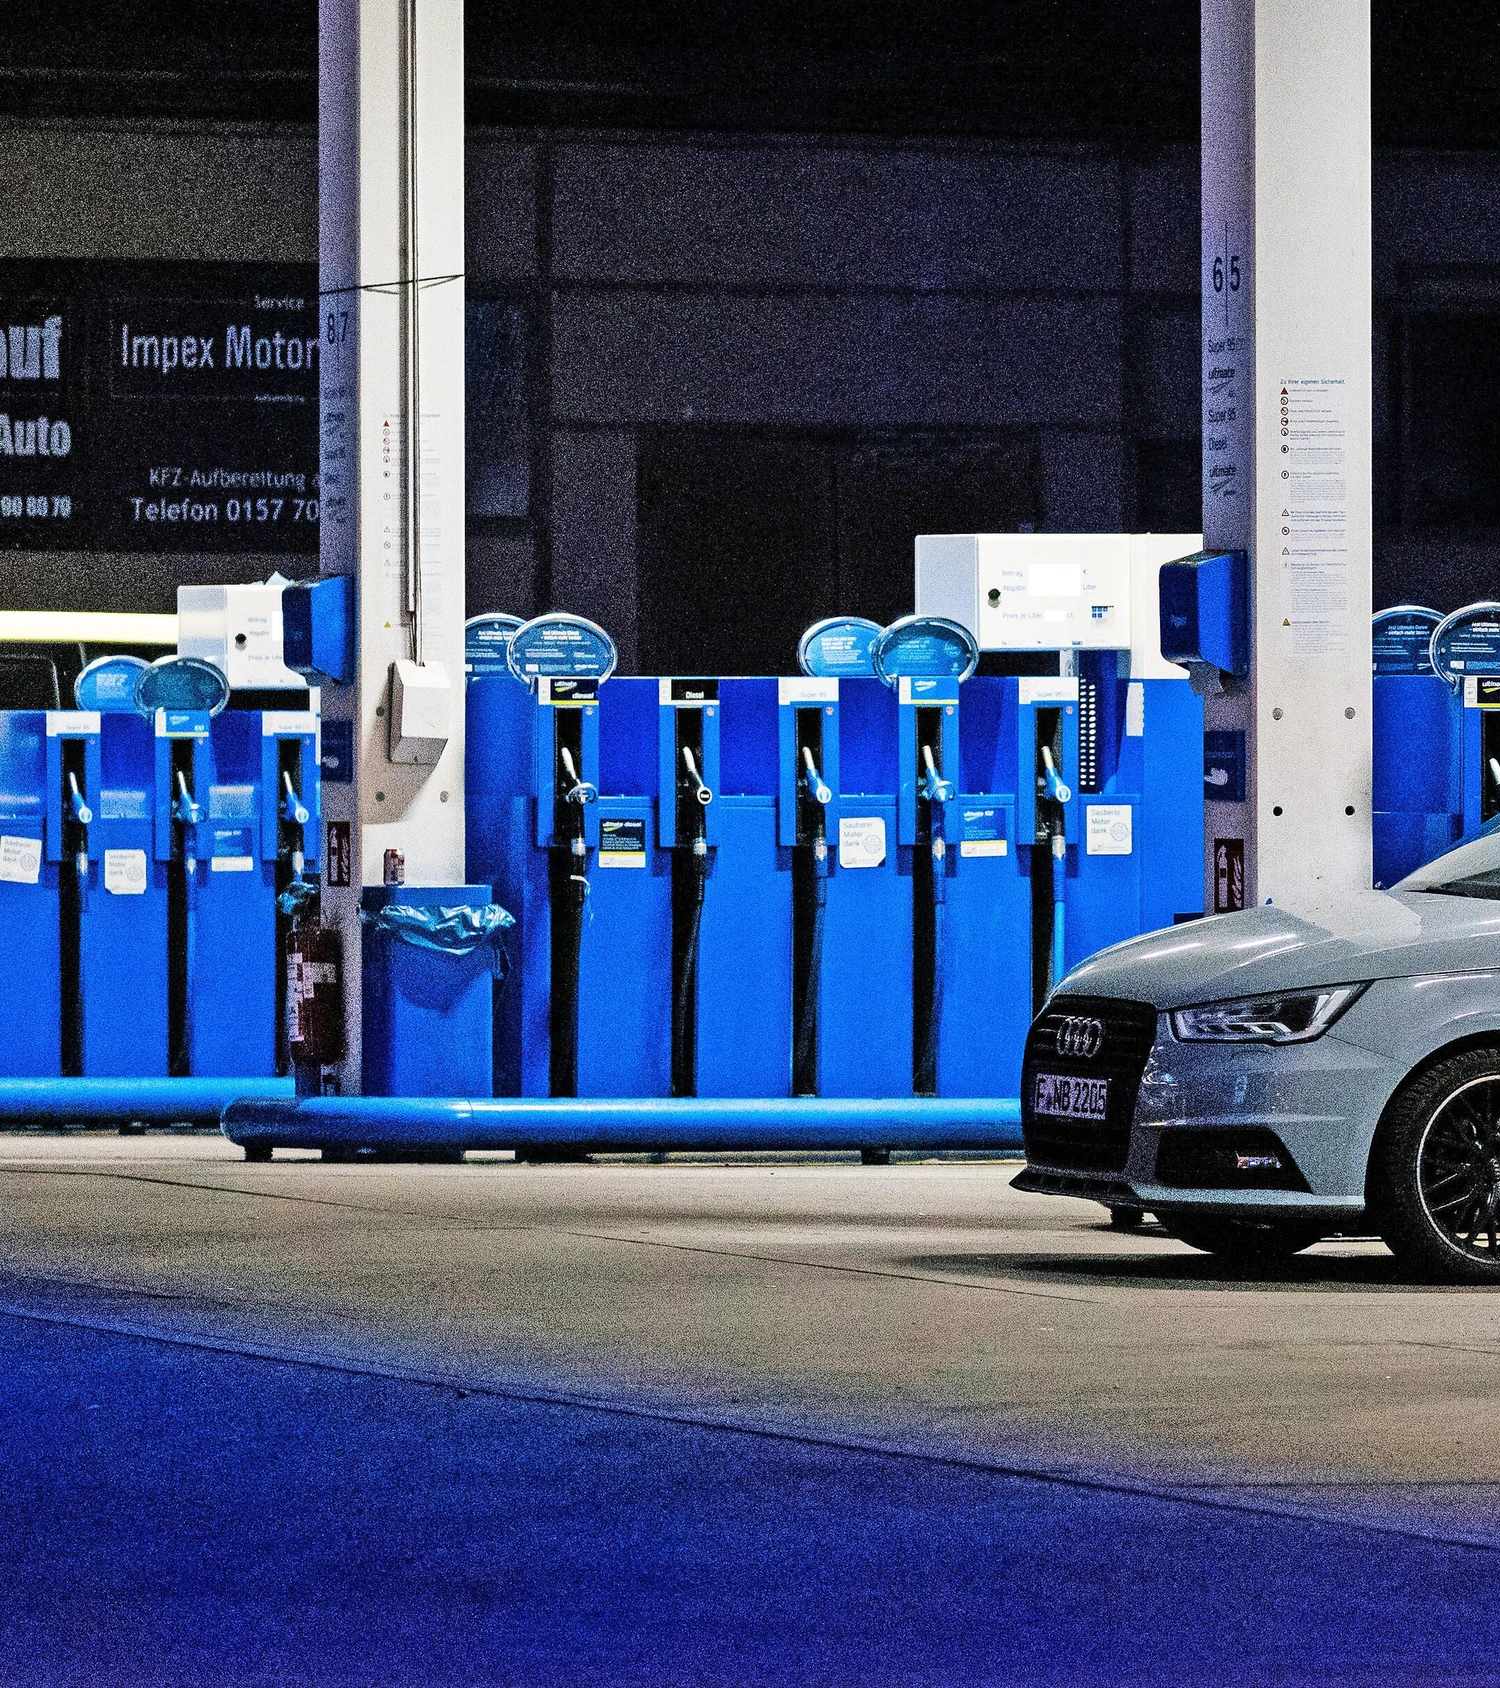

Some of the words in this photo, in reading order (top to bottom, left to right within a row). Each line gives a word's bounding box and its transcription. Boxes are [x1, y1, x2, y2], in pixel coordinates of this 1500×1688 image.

[1212, 256, 1223, 293] 6
[1230, 255, 1241, 292] 5
[327, 313, 335, 345] 8
[341, 311, 349, 344] 7
[122, 323, 214, 373] Impex
[149, 467, 307, 491] KFZ-Aufbereitung
[129, 497, 219, 522] Telefon
[226, 498, 285, 522] 0157
[685, 690, 705, 699] Diesel
[1036, 1078, 1046, 1109] F
[1053, 1079, 1071, 1112] NB
